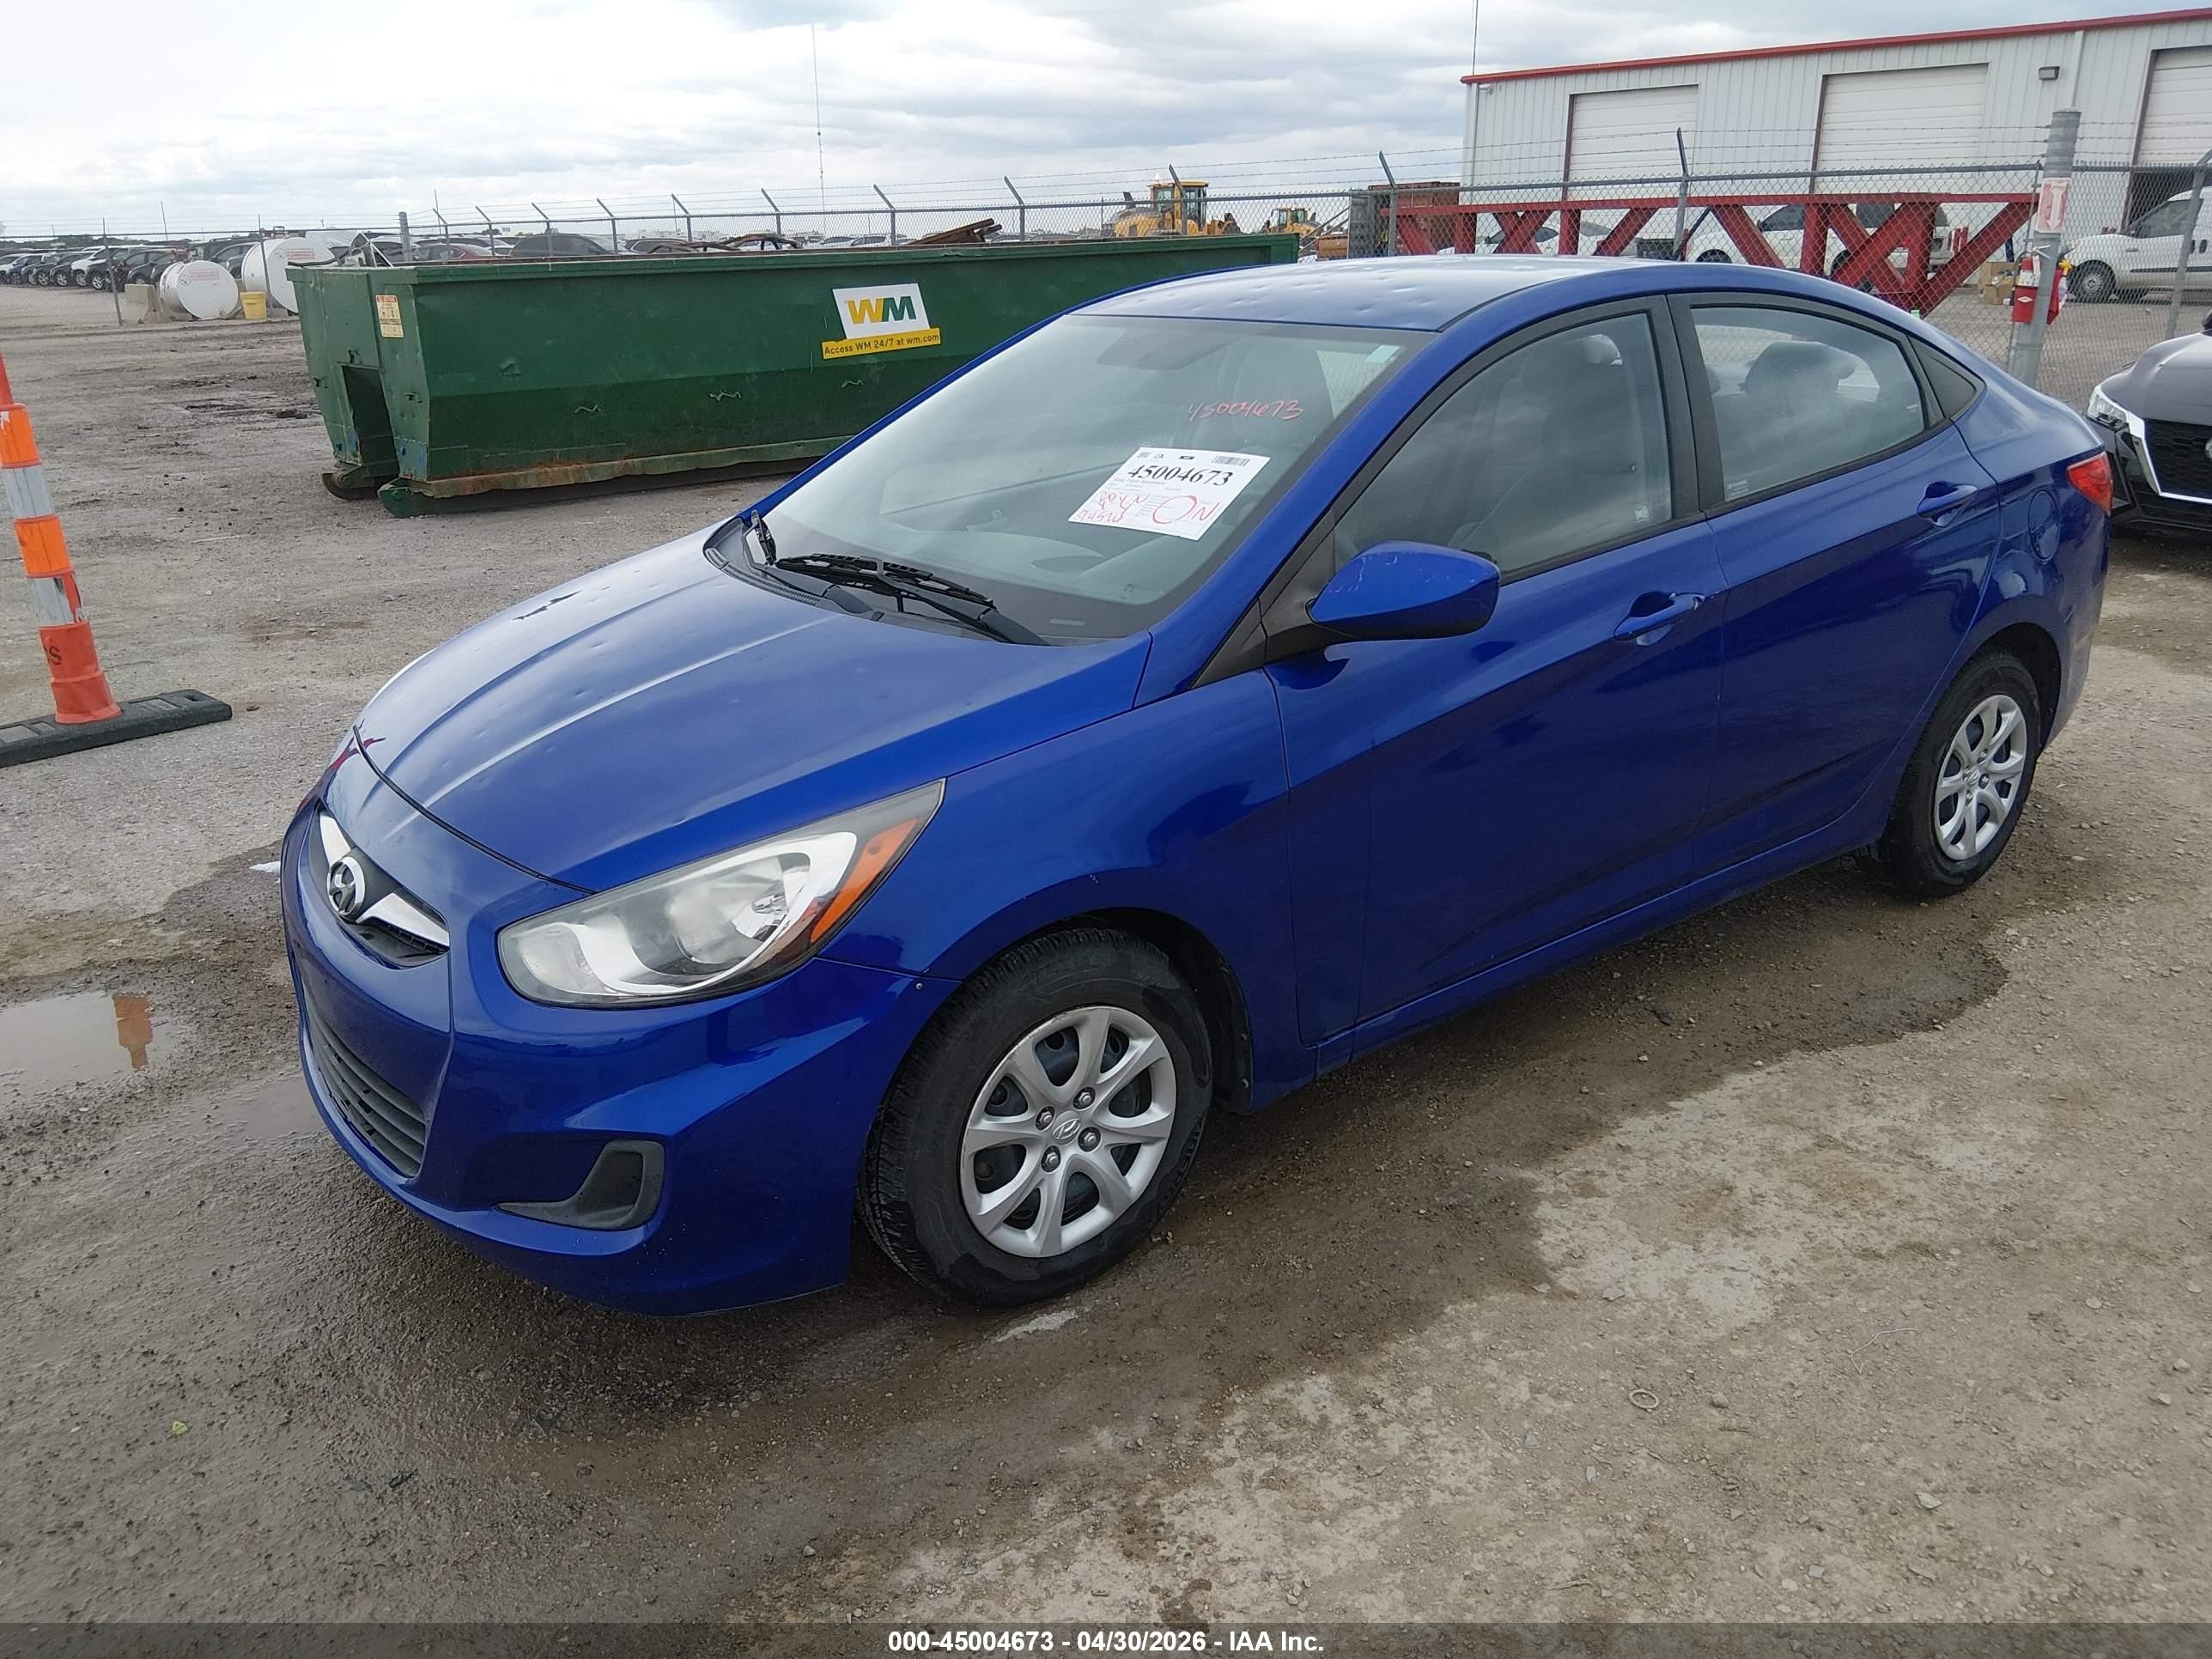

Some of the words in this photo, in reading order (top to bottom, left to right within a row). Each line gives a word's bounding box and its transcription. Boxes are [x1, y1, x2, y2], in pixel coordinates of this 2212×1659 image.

[847, 296, 916, 324] WM
[824, 344, 853, 356] Access
[855, 342, 872, 350] WM
[873, 338, 894, 349] 24/7
[906, 335, 939, 344] wm.com
[1188, 399, 1304, 421] 45004673
[1127, 465, 1233, 486] 45004673
